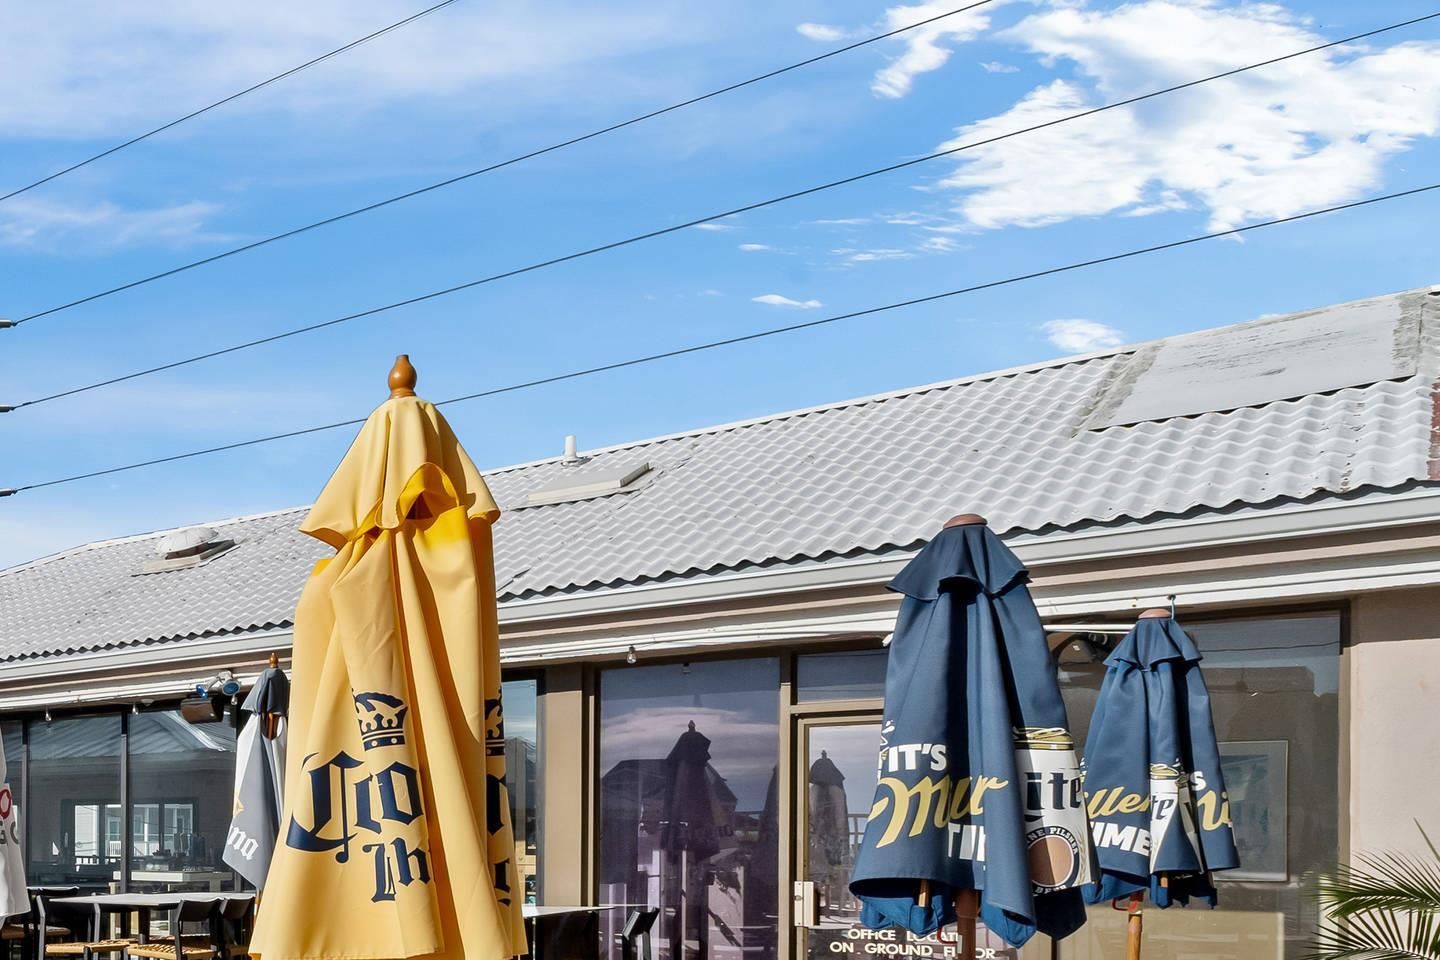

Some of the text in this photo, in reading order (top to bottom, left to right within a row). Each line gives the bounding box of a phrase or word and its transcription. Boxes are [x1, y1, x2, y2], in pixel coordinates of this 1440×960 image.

[888, 744, 947, 772] IT'S
[847, 928, 896, 941] OFFICE
[829, 941, 855, 954] ON
[864, 942, 933, 957] GROUND
